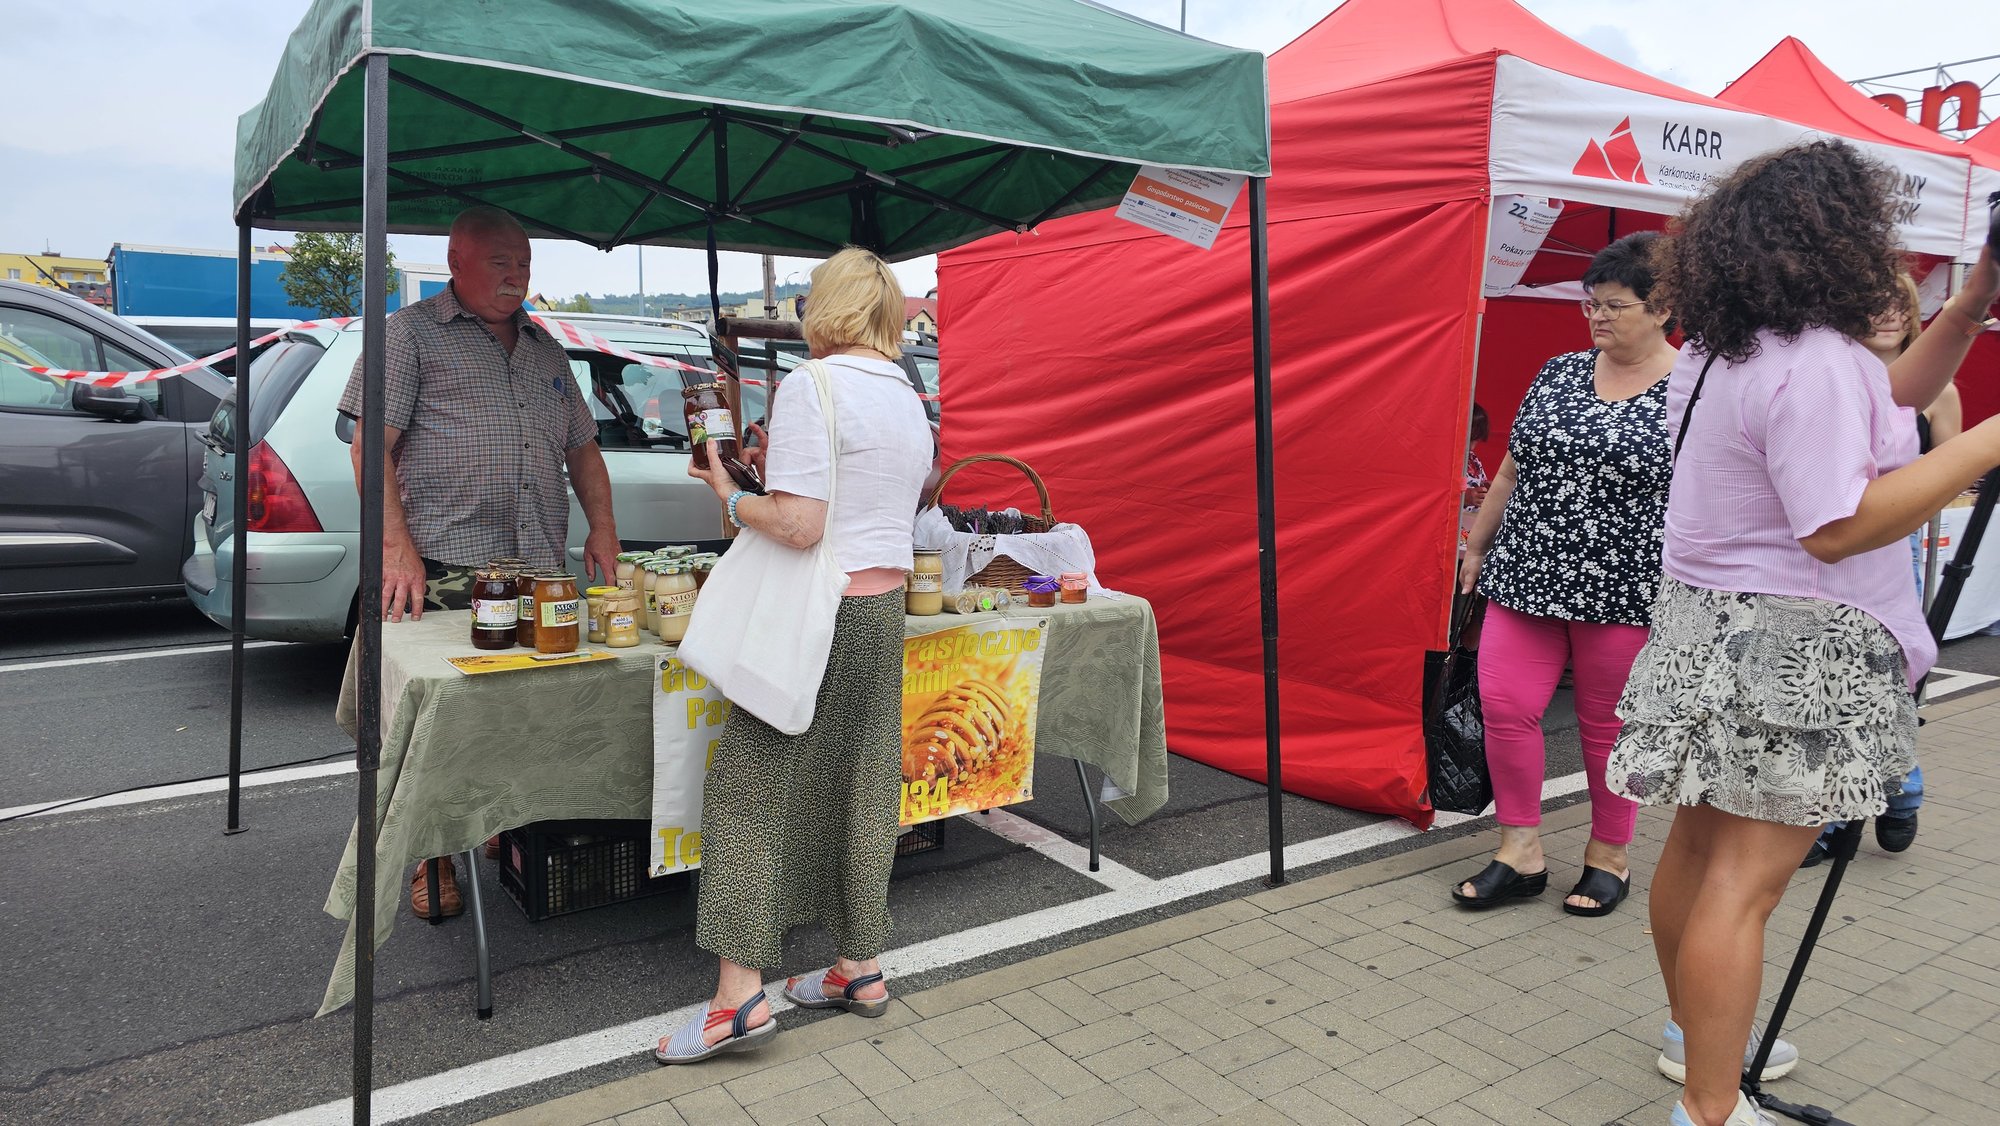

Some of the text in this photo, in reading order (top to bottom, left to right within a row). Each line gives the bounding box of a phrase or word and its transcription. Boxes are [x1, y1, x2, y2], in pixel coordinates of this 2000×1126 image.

[1662, 121, 1722, 160] KARR
[1659, 164, 1701, 182] Karkonoska
[1146, 184, 1184, 203] Gospodarstwo
[1508, 202, 1528, 220] 22.
[1500, 243, 1525, 256] Pokazy
[904, 627, 1042, 663] Pasieczne
